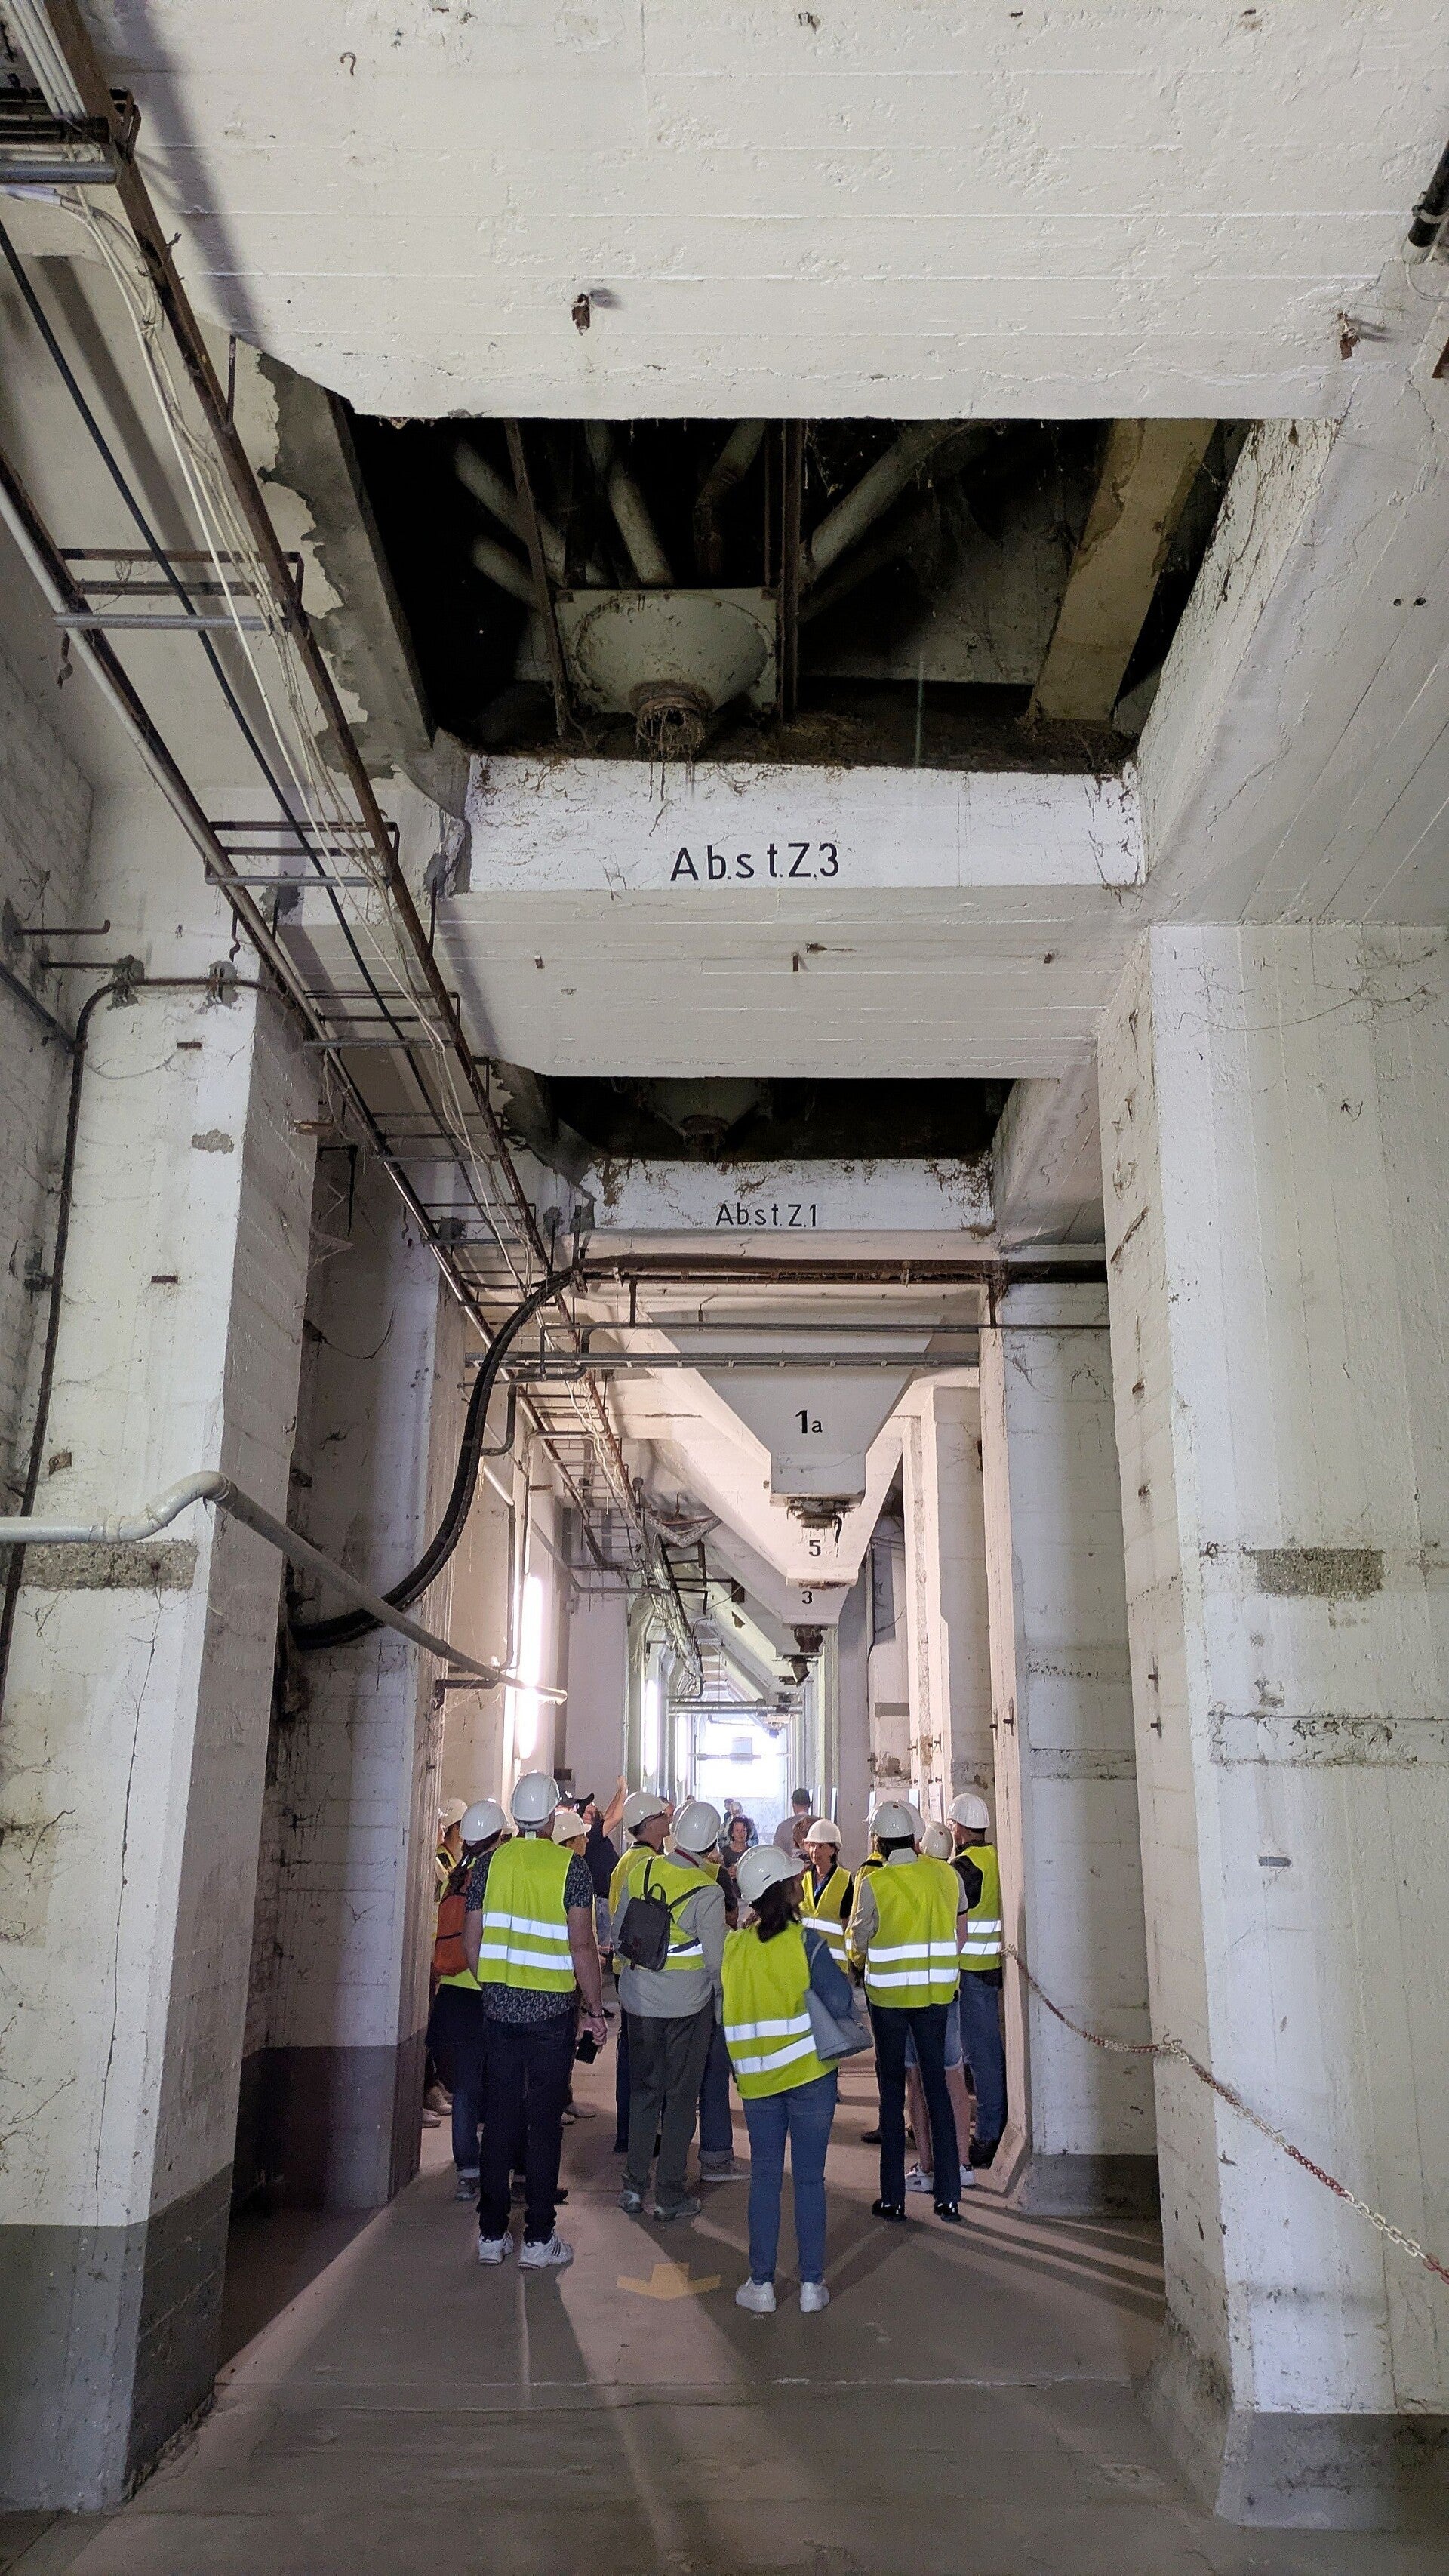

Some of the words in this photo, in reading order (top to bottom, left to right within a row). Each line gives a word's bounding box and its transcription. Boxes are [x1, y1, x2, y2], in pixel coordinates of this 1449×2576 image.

[795, 1410, 823, 1434] 1a
[809, 1540, 821, 1556] 5
[802, 1590, 813, 1604] 3
